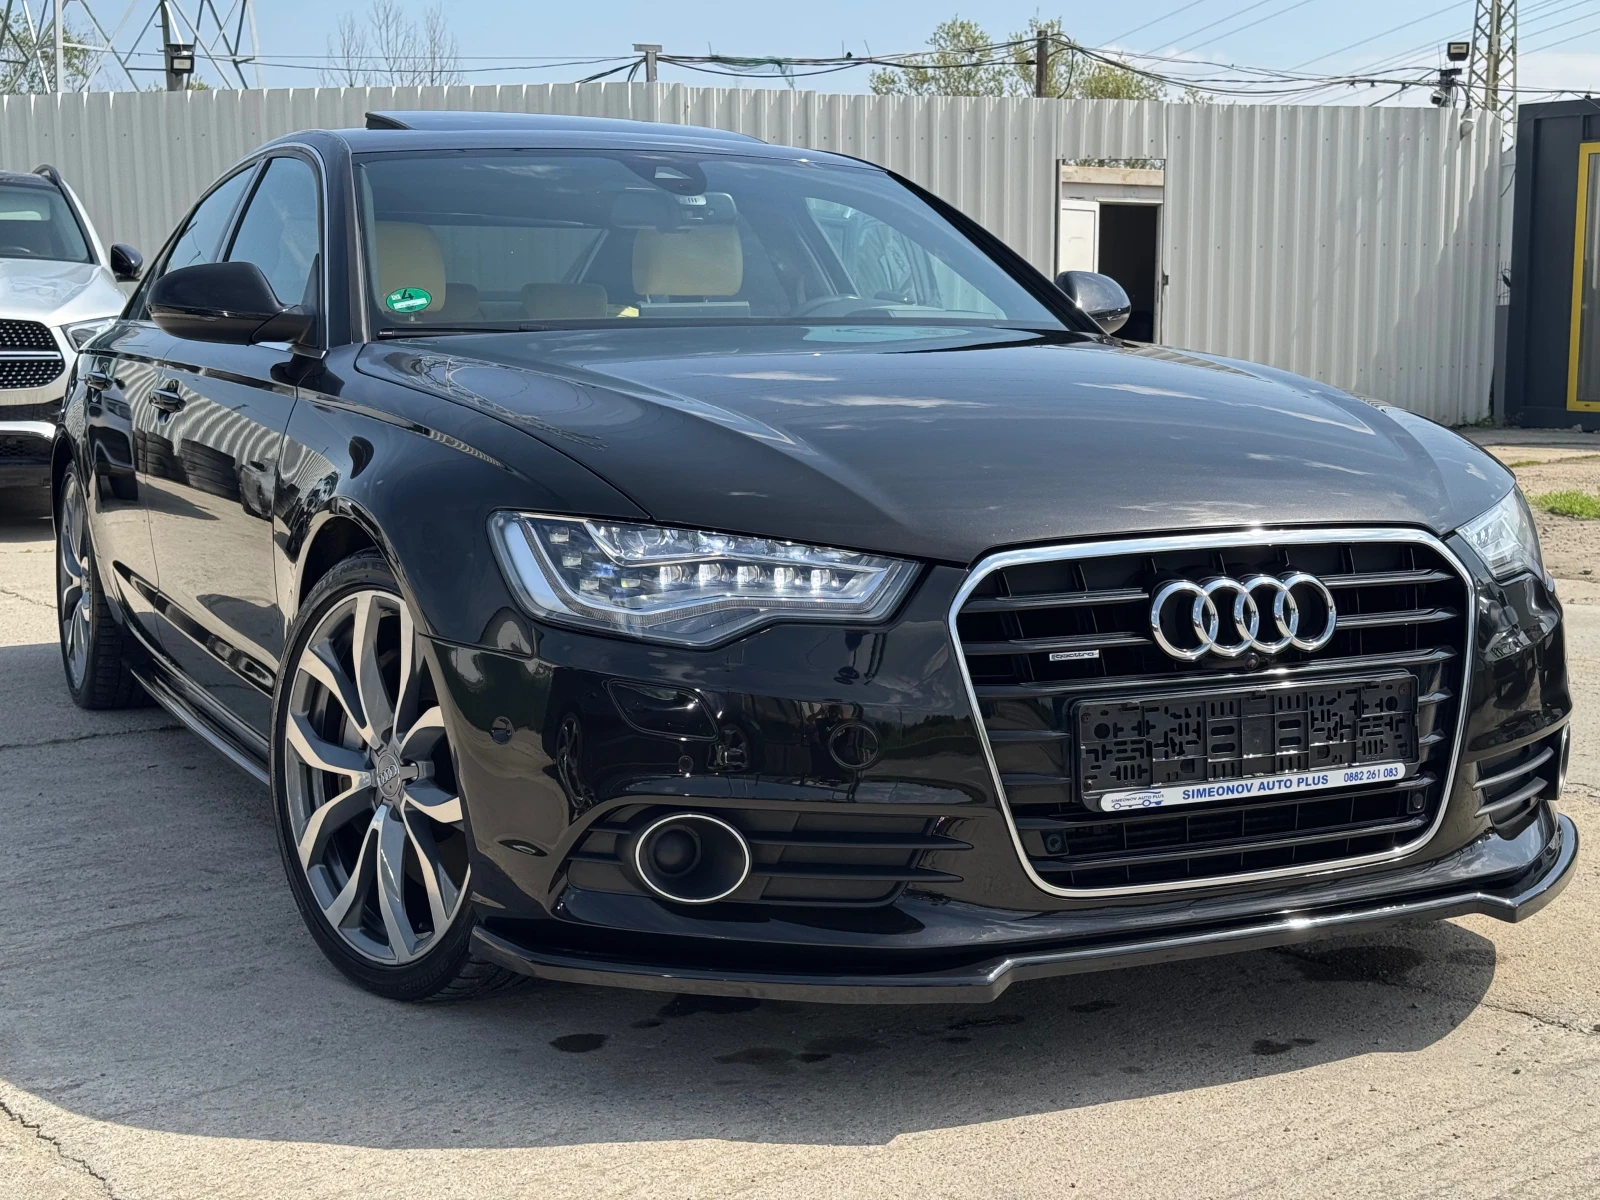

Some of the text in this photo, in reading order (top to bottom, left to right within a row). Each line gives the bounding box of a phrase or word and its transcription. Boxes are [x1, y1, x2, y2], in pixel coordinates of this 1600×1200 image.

[1182, 766, 1399, 800] SIMEONOV AUTO PLUS 0882 261 083
